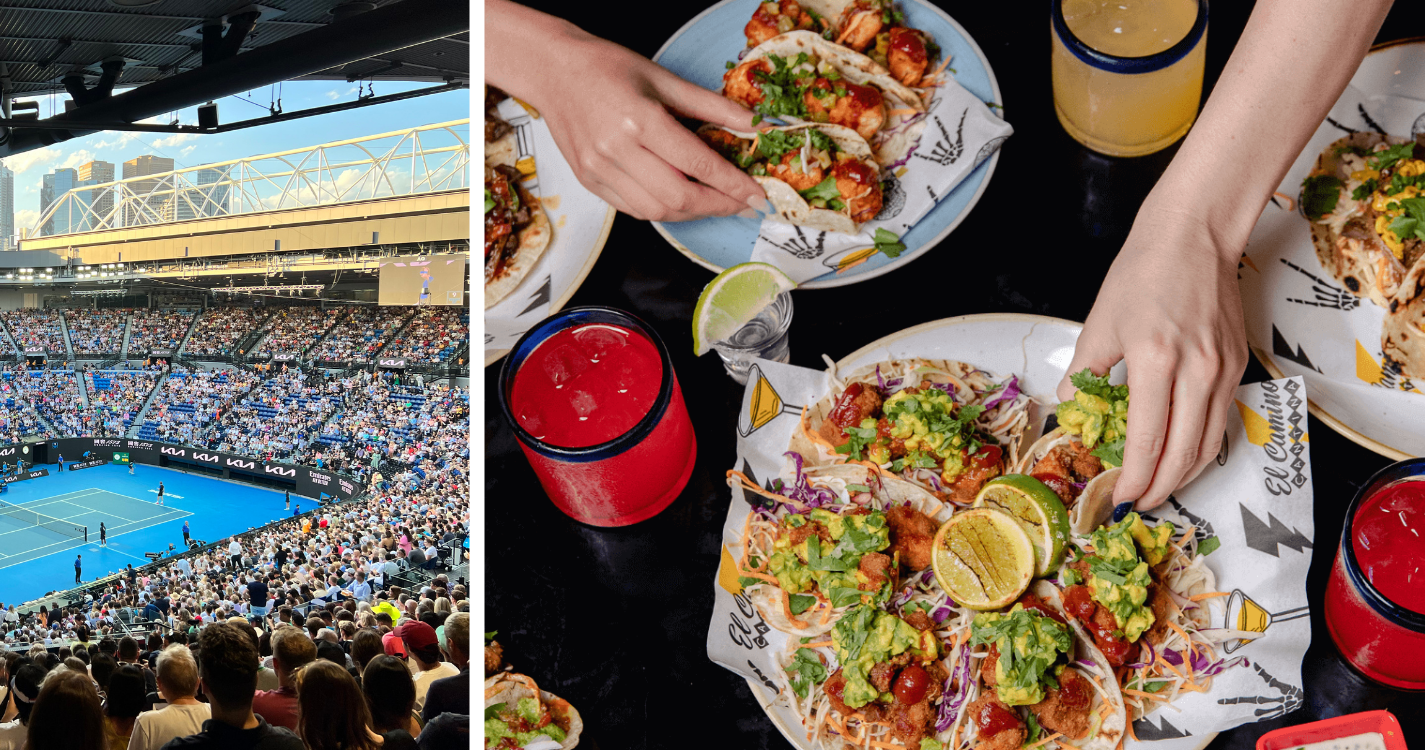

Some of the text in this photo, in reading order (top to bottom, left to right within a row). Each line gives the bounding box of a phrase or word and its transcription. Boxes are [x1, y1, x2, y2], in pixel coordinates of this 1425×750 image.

[161, 446, 185, 457] KIA
[193, 452, 219, 463] KIA
[226, 458, 255, 470] KIA
[265, 464, 296, 477] KIA
[1260, 380, 1292, 496] El Camino
[1285, 381, 1305, 487] CANTINA
